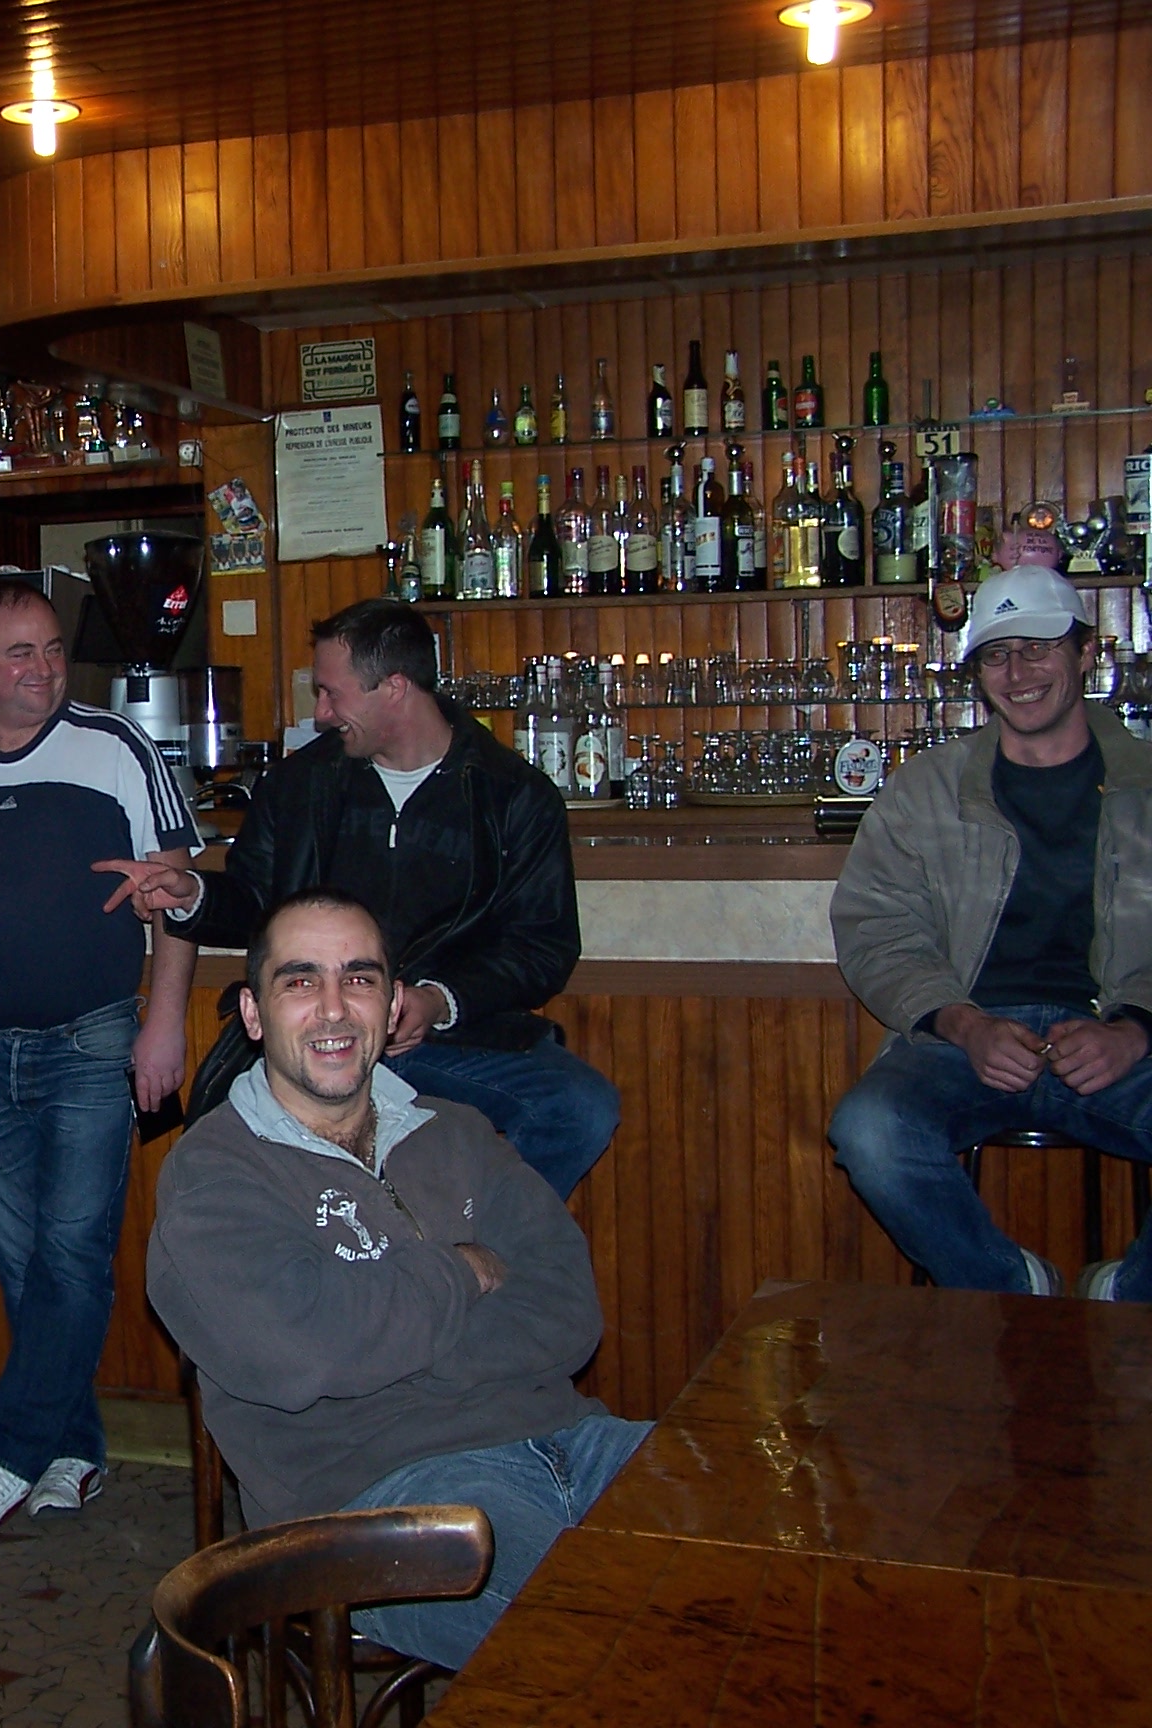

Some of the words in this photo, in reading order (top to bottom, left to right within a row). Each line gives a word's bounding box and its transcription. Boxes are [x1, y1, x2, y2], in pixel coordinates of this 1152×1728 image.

[315, 356, 326, 365] LA
[328, 353, 361, 364] MAISON
[285, 425, 325, 437] PROTECTION
[327, 424, 340, 433] DES
[343, 421, 372, 432] MINEURS
[925, 432, 951, 455] 51
